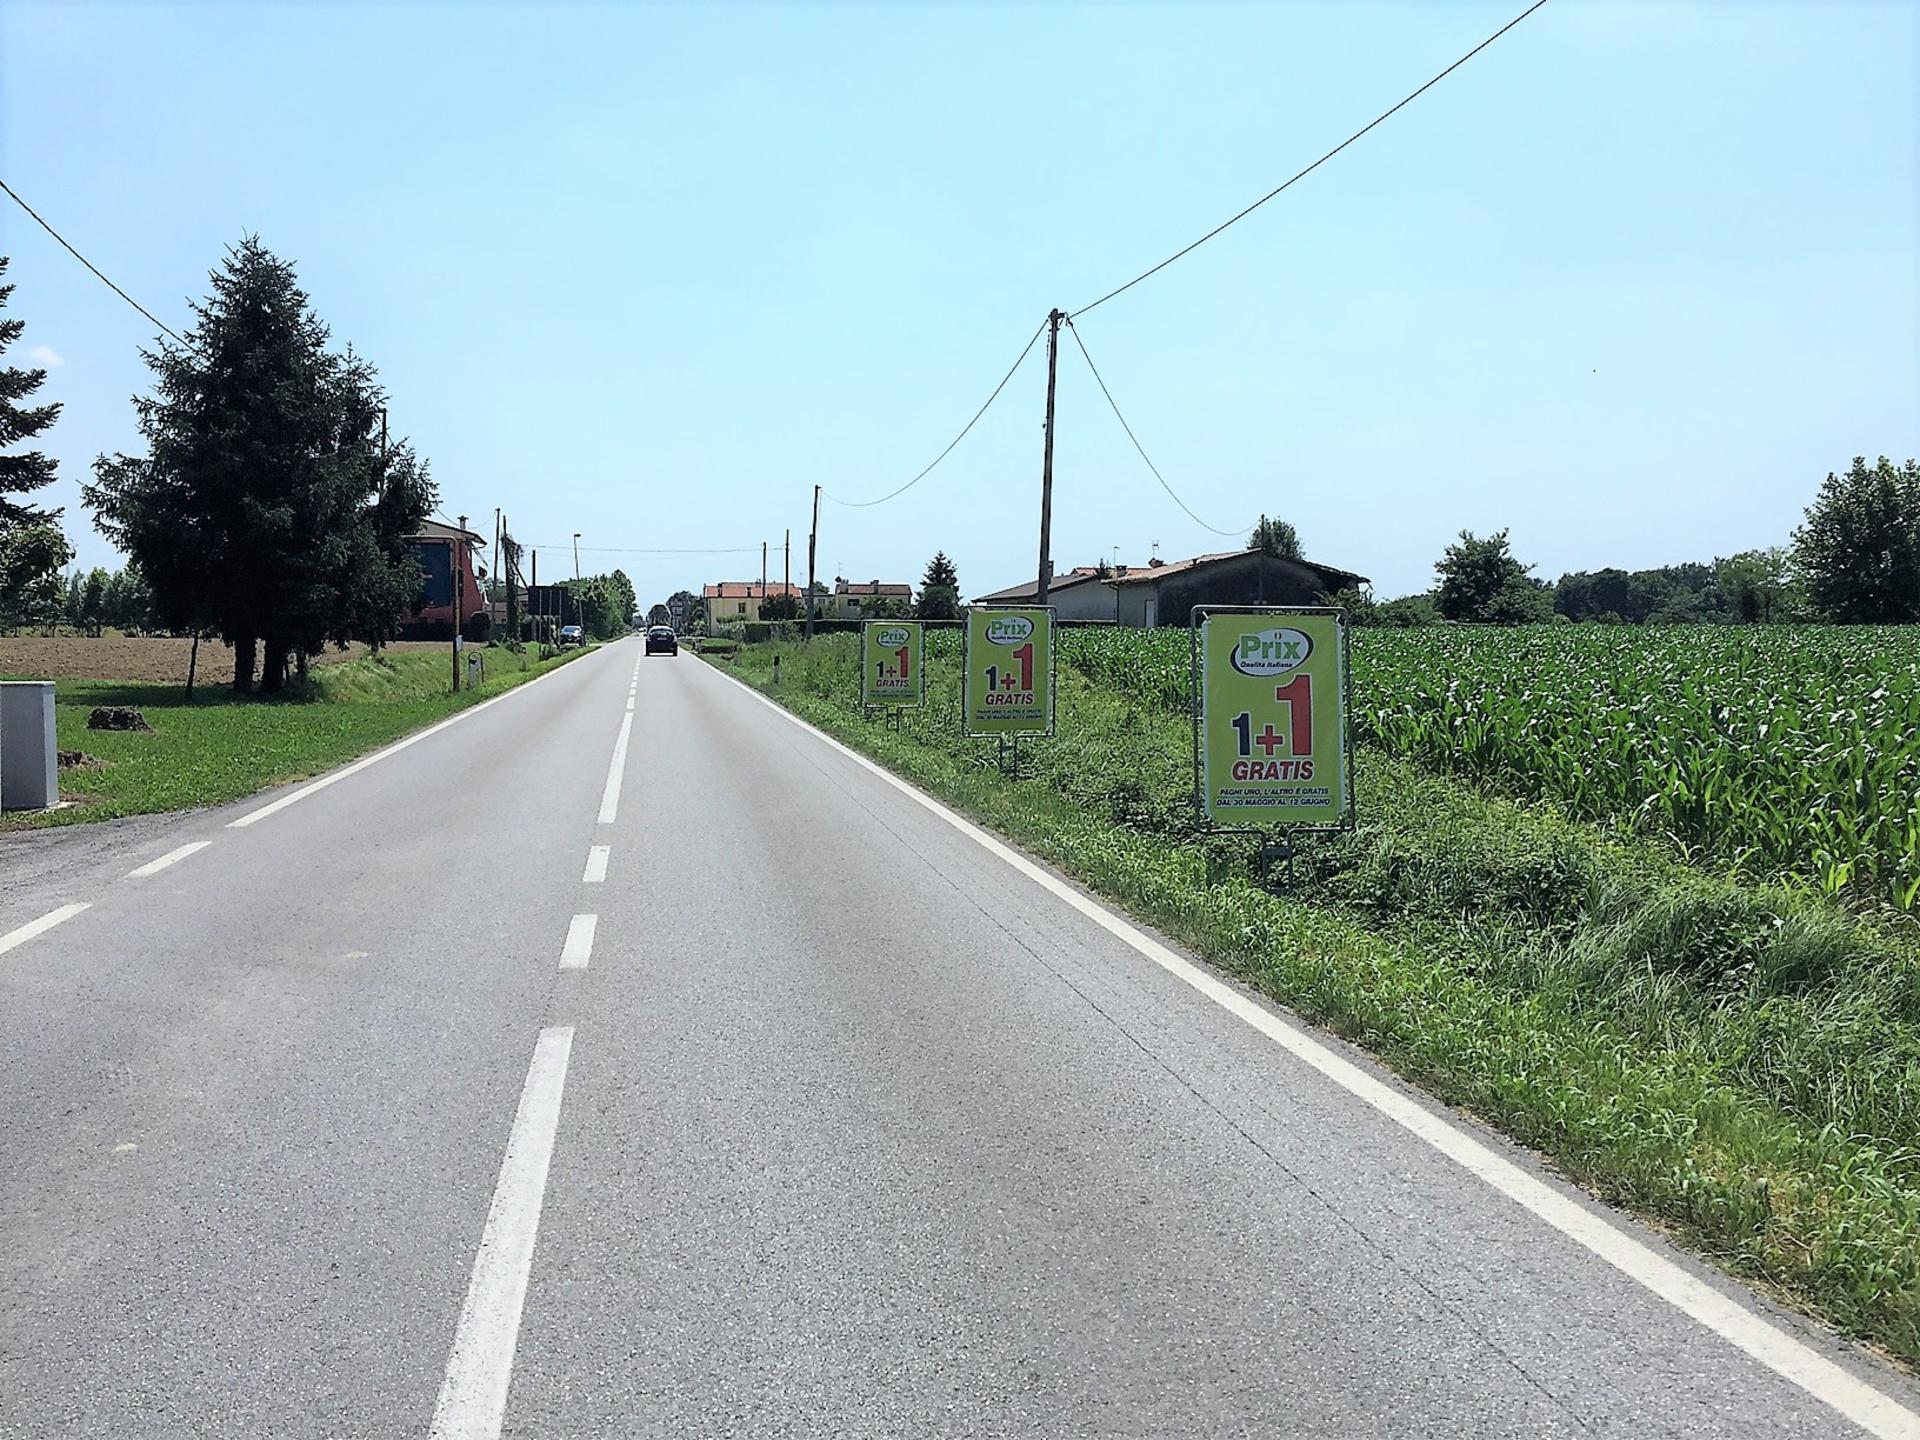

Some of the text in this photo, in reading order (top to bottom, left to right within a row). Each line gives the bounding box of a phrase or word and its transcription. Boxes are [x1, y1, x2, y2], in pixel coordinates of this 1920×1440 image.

[991, 619, 1028, 635] Prix
[880, 630, 905, 641] Prix
[1240, 632, 1301, 660] Prix
[876, 679, 909, 688] GRATIS
[985, 693, 1034, 705] GRATIS
[1232, 760, 1315, 782] GRATIS
[1219, 788, 1242, 796] PAGHI
[1301, 787, 1329, 795] GRATIS
[1300, 798, 1331, 806] GIUGNO
